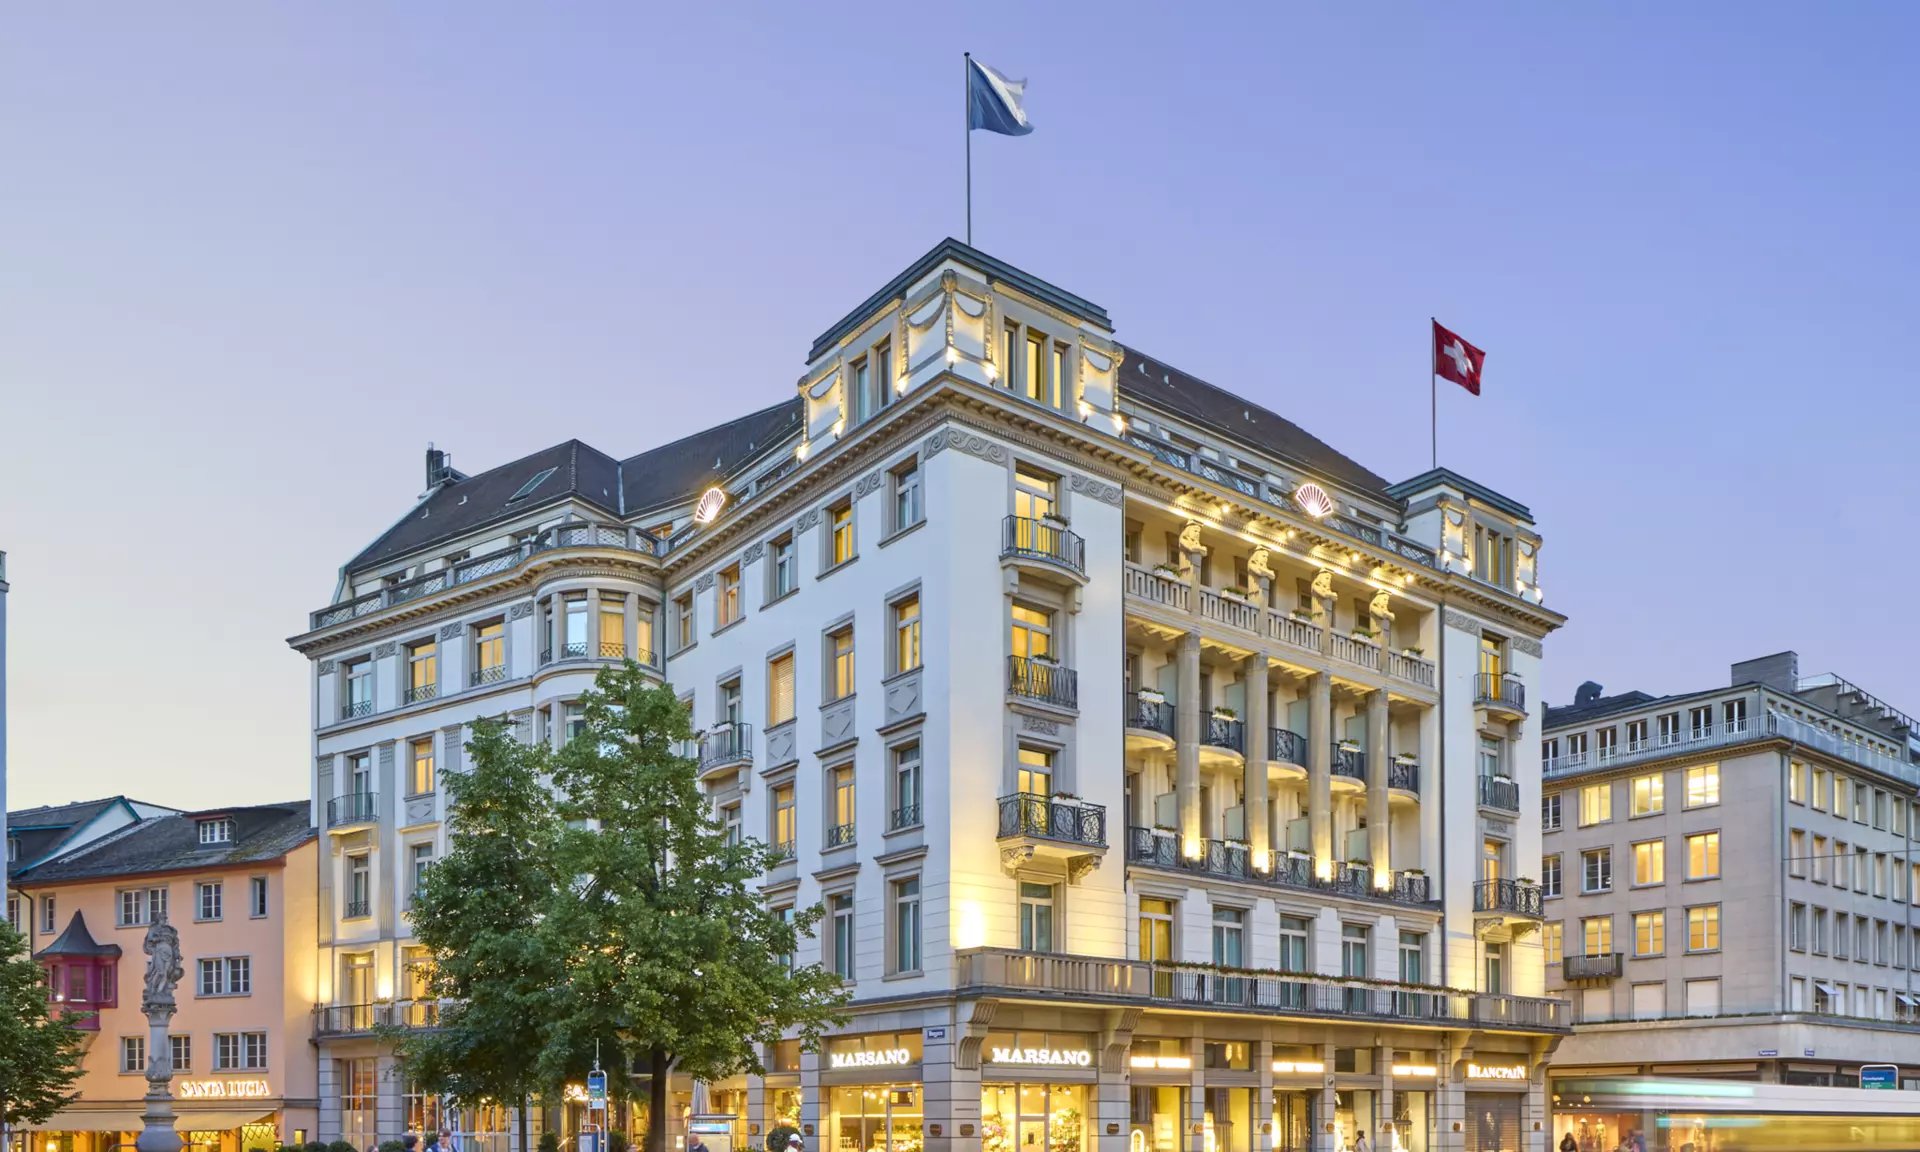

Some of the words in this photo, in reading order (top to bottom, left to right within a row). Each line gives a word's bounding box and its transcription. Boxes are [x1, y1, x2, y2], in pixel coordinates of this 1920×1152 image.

[831, 1048, 910, 1067] MARSANO
[992, 1047, 1091, 1066] MARSANO
[1468, 1063, 1526, 1079] BLANCPAIN
[180, 1081, 226, 1097] SANTA
[227, 1080, 270, 1097] LUCIA
